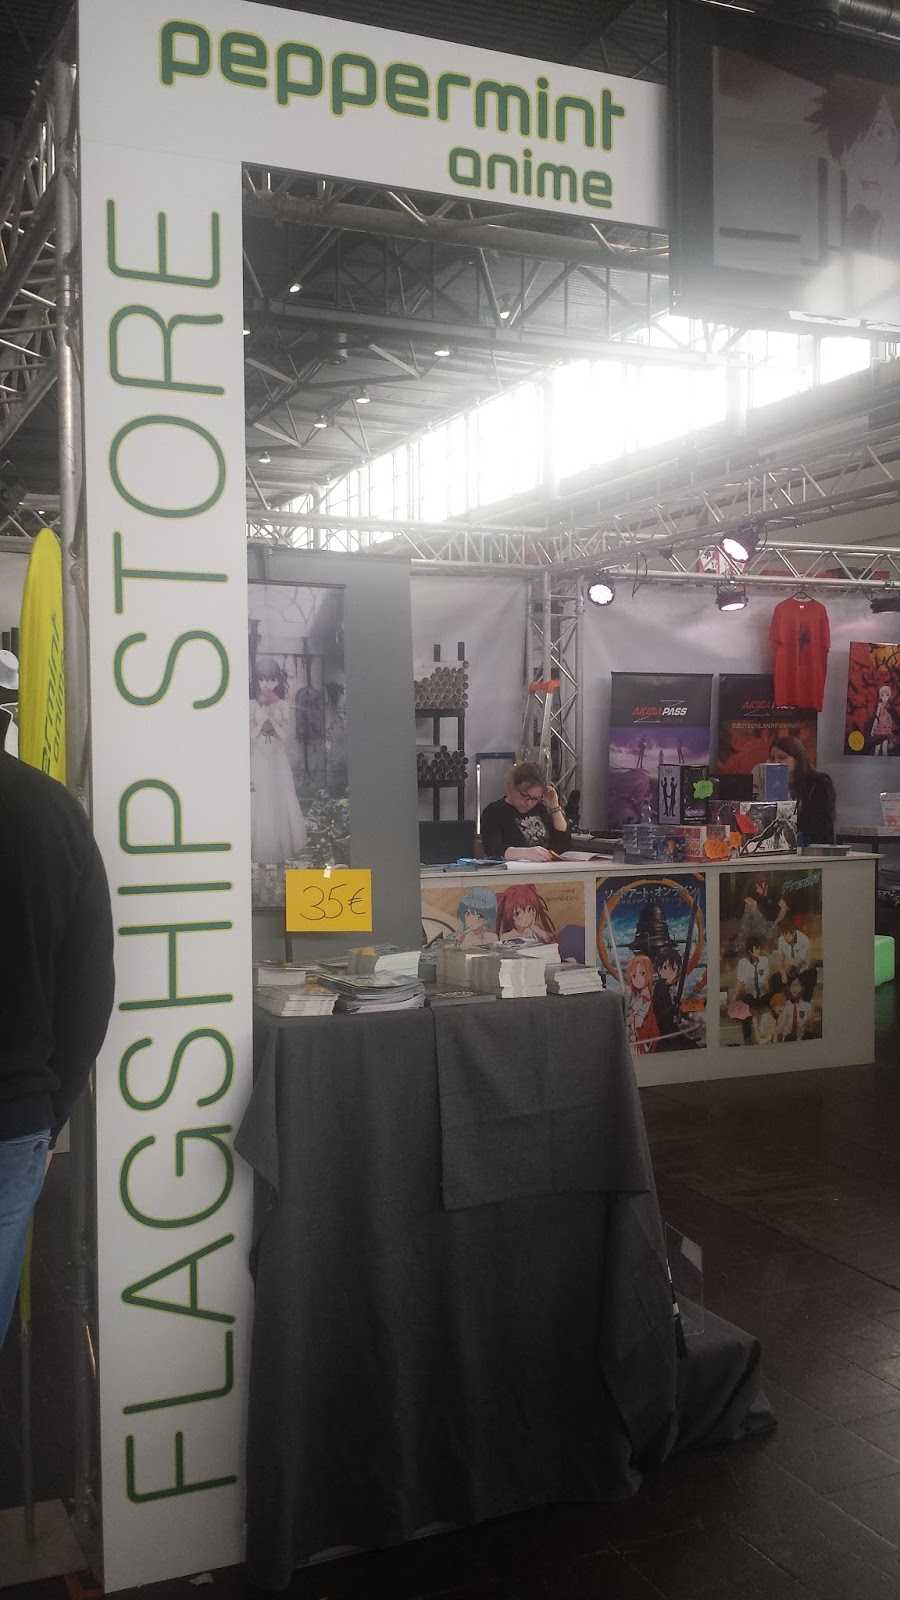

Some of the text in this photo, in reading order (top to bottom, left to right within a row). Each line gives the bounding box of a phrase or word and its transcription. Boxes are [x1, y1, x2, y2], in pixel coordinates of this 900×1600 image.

[159, 18, 626, 151] peppermint
[449, 146, 614, 209] anime
[105, 199, 240, 1504] FLAGSHIP STORE
[299, 882, 368, 921] 35€
